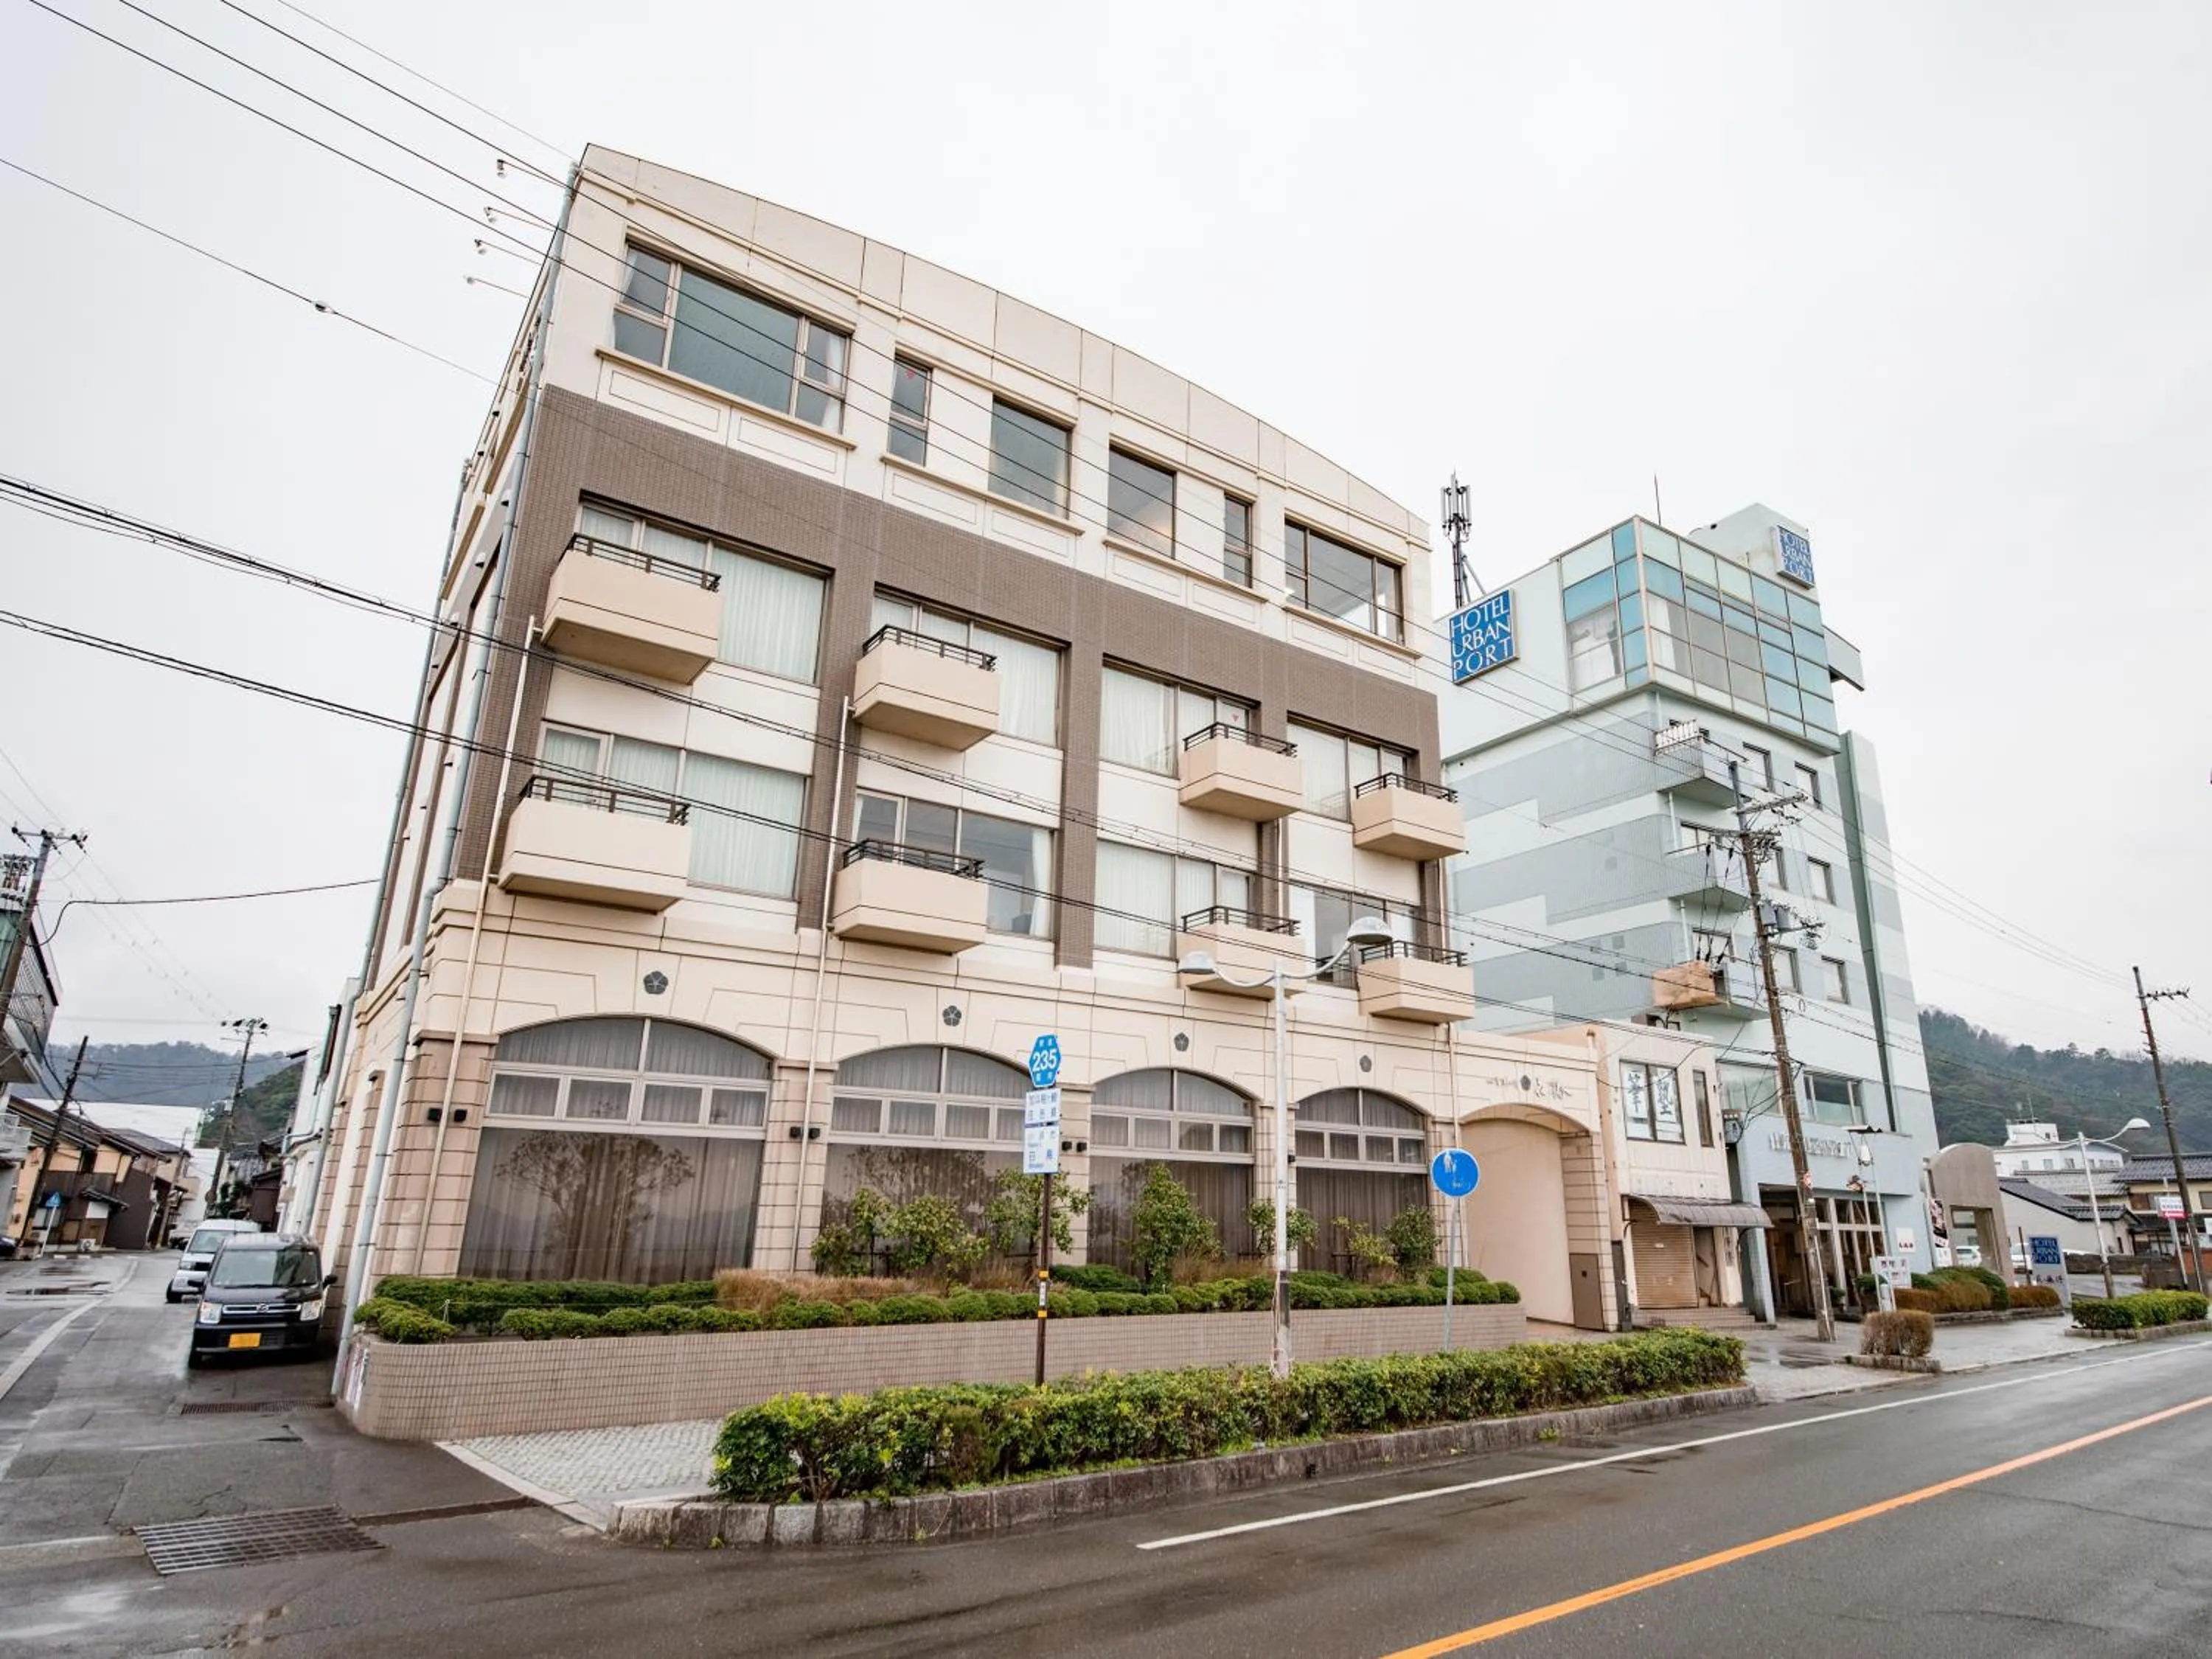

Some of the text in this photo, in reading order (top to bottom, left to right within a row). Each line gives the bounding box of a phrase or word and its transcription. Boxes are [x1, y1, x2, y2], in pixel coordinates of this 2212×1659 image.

[1450, 595, 1509, 633] HOTEL
[1452, 614, 1511, 657] URBAN
[1453, 636, 1511, 679] PORT
[1032, 1048, 1057, 1072] 235
